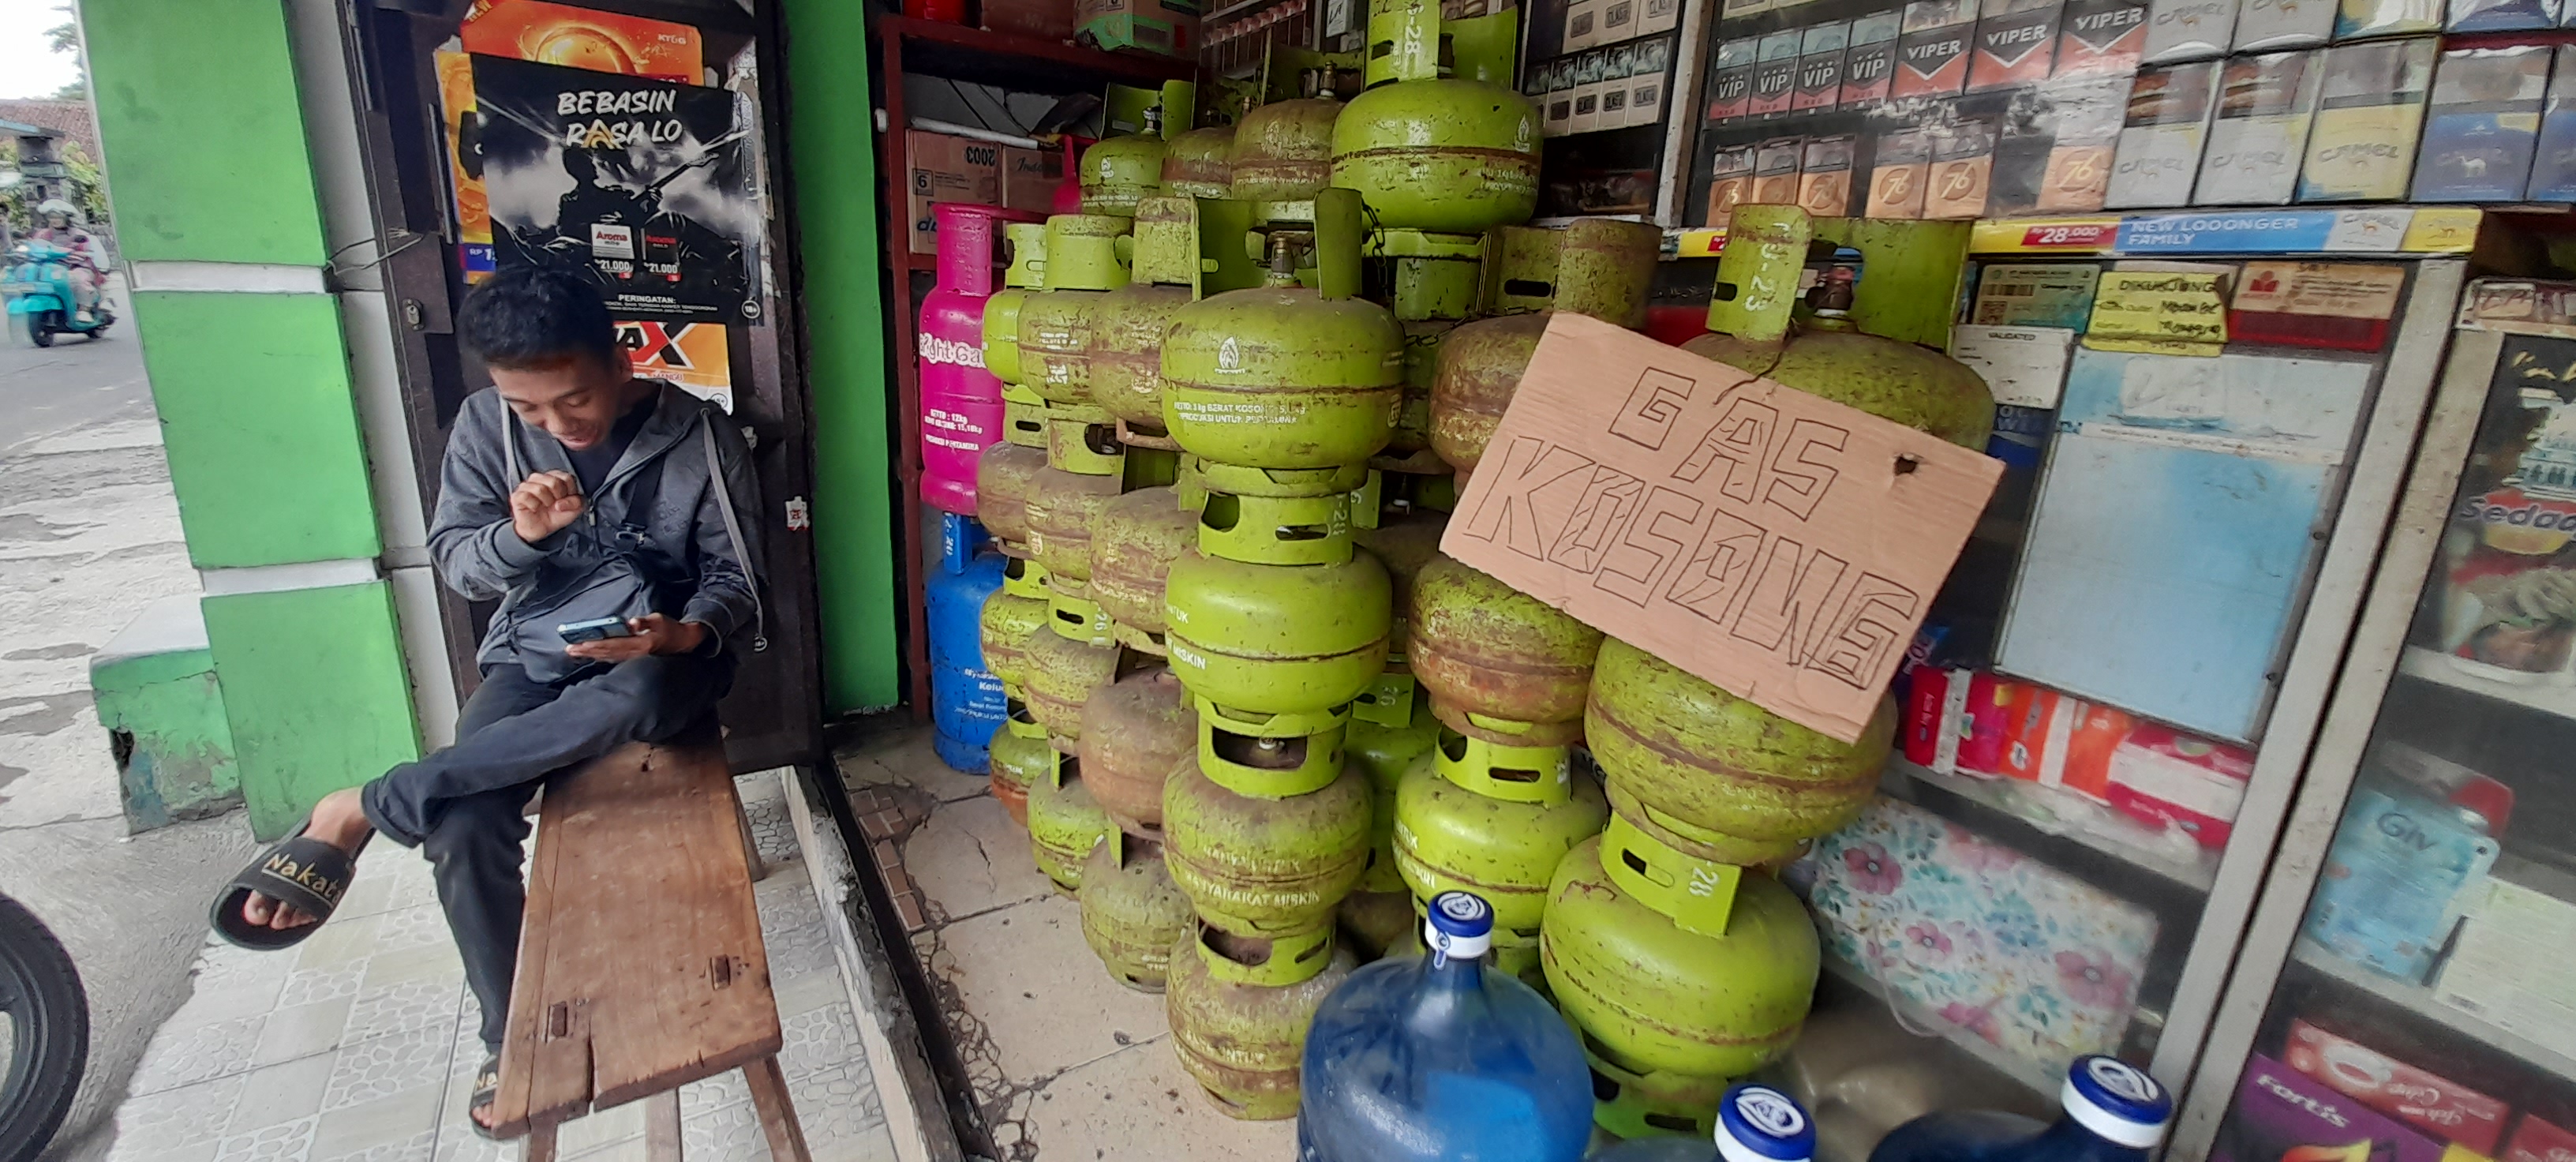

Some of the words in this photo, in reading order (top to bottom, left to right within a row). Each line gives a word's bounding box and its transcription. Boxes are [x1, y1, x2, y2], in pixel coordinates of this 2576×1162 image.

[2075, 6, 2145, 30] VIPER
[1986, 24, 2048, 47] VIPER
[1907, 39, 1963, 61] VIPER
[1803, 66, 1836, 88] VIP
[1852, 58, 1886, 81] VIP
[1719, 80, 1745, 99] VIP
[1760, 73, 1789, 94] VIP
[557, 89, 677, 116] BEBASIN
[565, 118, 644, 150] RASA
[650, 118, 683, 143] LO
[2317, 142, 2400, 163] CAMEL
[1880, 168, 1911, 202] 76
[1939, 162, 1974, 199] 76
[596, 231, 628, 242] Aroma
[2131, 221, 2170, 234] NEW
[2177, 217, 2299, 232] LOOONGER
[2128, 234, 2196, 246] FAMILY
[600, 260, 631, 272] 21.000
[649, 262, 678, 274] 21.000
[618, 294, 676, 305] PERINGATAN:
[1608, 365, 1850, 523] GAS
[1462, 434, 1919, 690] KOSONG
[2377, 812, 2439, 851] Giv
[1273, 891, 1321, 907] MISKIN
[2256, 1074, 2351, 1130] Fortis
